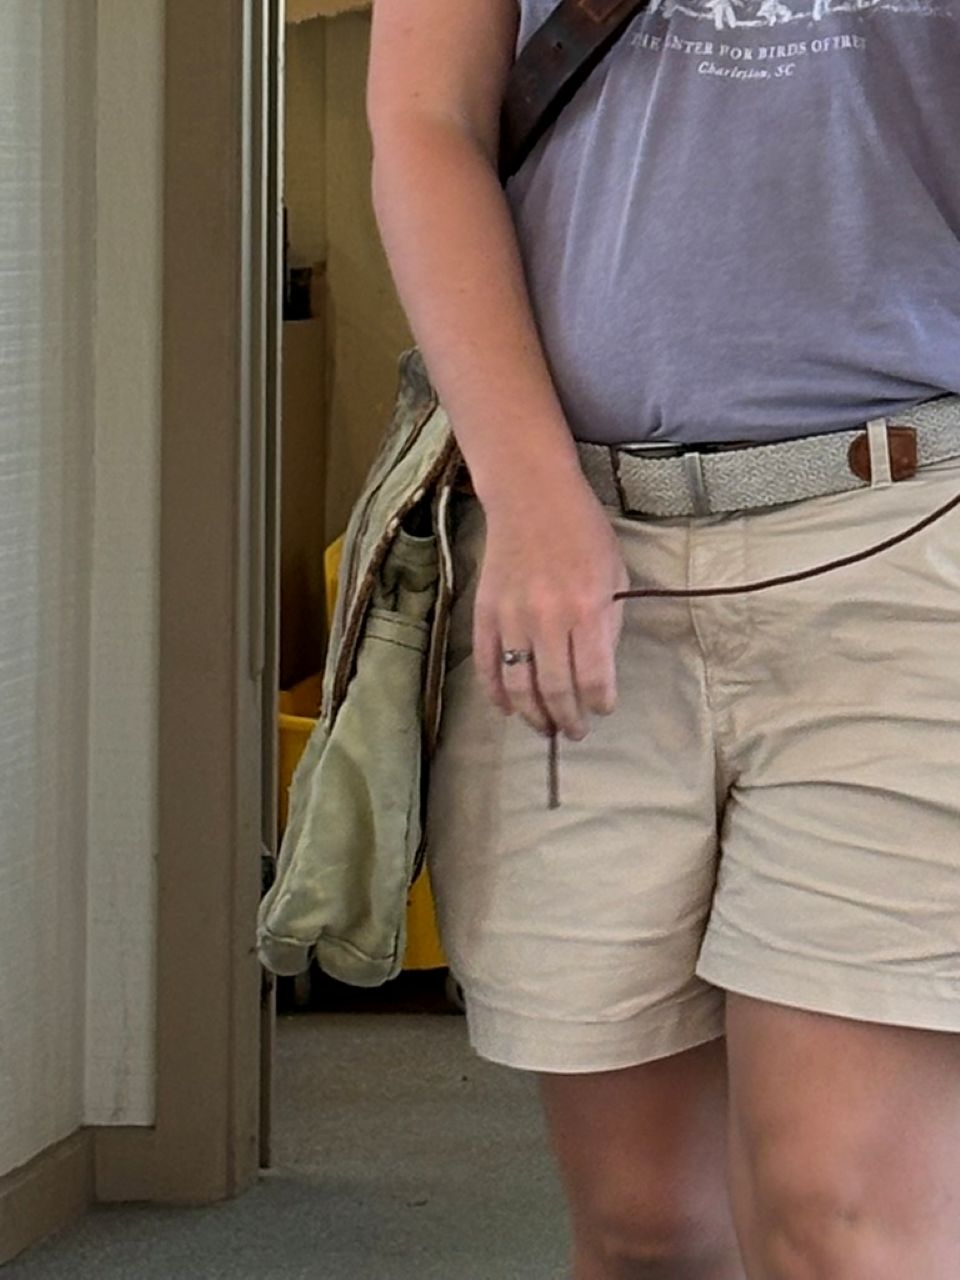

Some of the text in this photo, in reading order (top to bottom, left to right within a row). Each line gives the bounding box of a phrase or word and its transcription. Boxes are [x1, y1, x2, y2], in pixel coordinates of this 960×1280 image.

[719, 44, 753, 60] FOR
[758, 43, 806, 60] BIRDS
[811, 39, 830, 53] OF
[774, 63, 796, 77] SC
